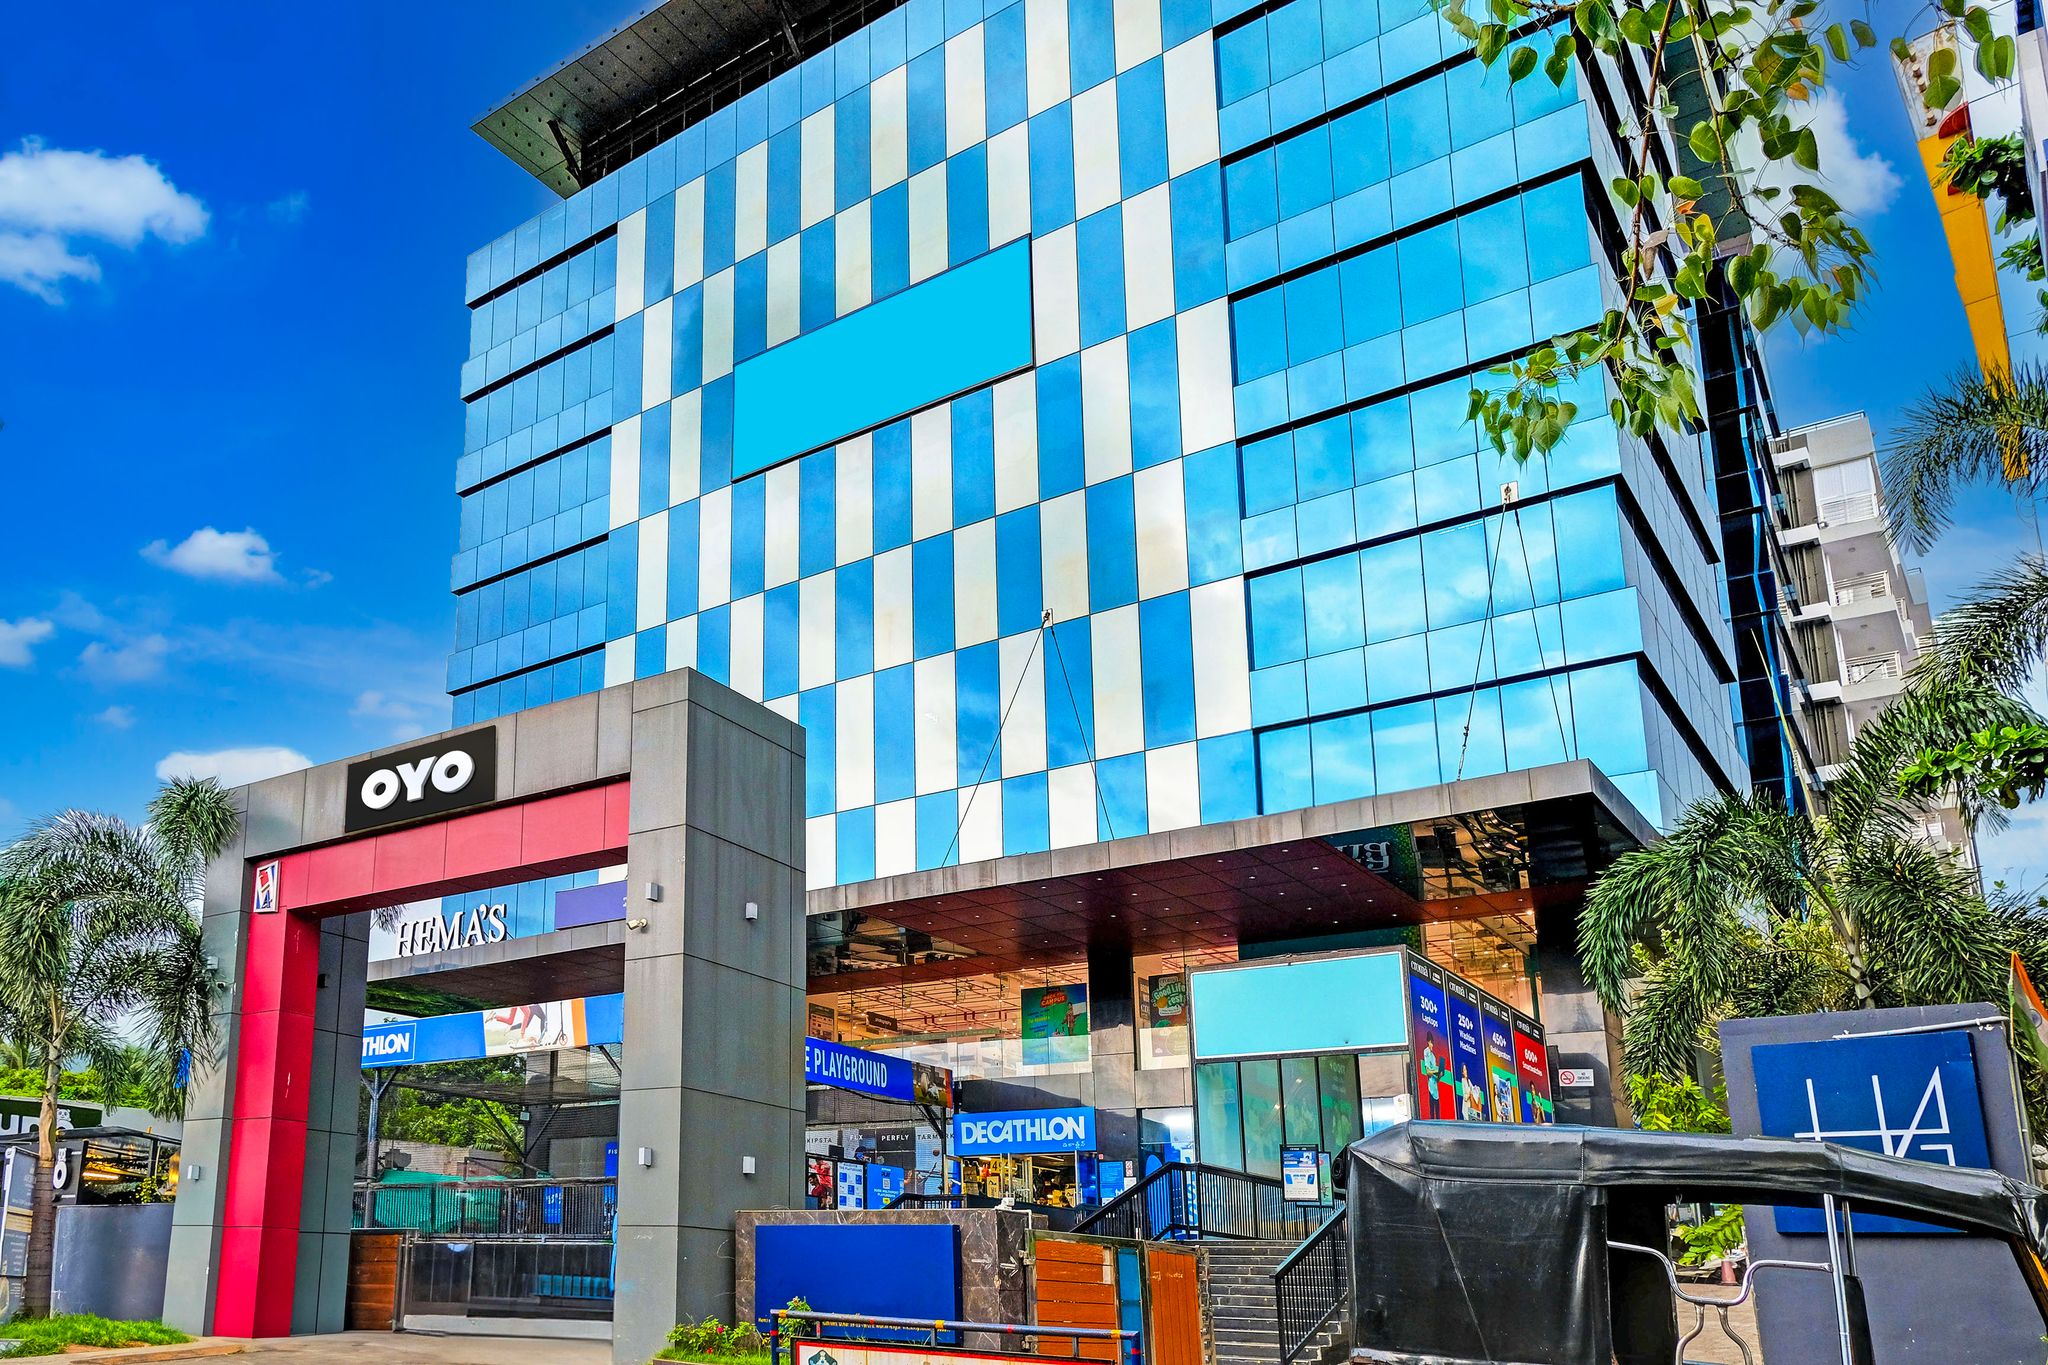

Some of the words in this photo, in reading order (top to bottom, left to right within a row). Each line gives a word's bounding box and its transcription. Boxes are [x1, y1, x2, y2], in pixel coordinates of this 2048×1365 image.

[361, 750, 475, 809] OYO
[398, 903, 507, 957] HEMA'S
[1420, 995, 1438, 1014] 300+
[1421, 1013, 1439, 1028] Laptops
[1457, 1013, 1474, 1030] 250+
[1459, 1029, 1476, 1045] Washing
[1492, 1031, 1507, 1047] 450+
[1459, 1040, 1477, 1055] Machines
[1524, 1048, 1538, 1064] 600+
[814, 1047, 888, 1088] PLAYGROUND
[961, 1116, 1086, 1145] DECATHLON
